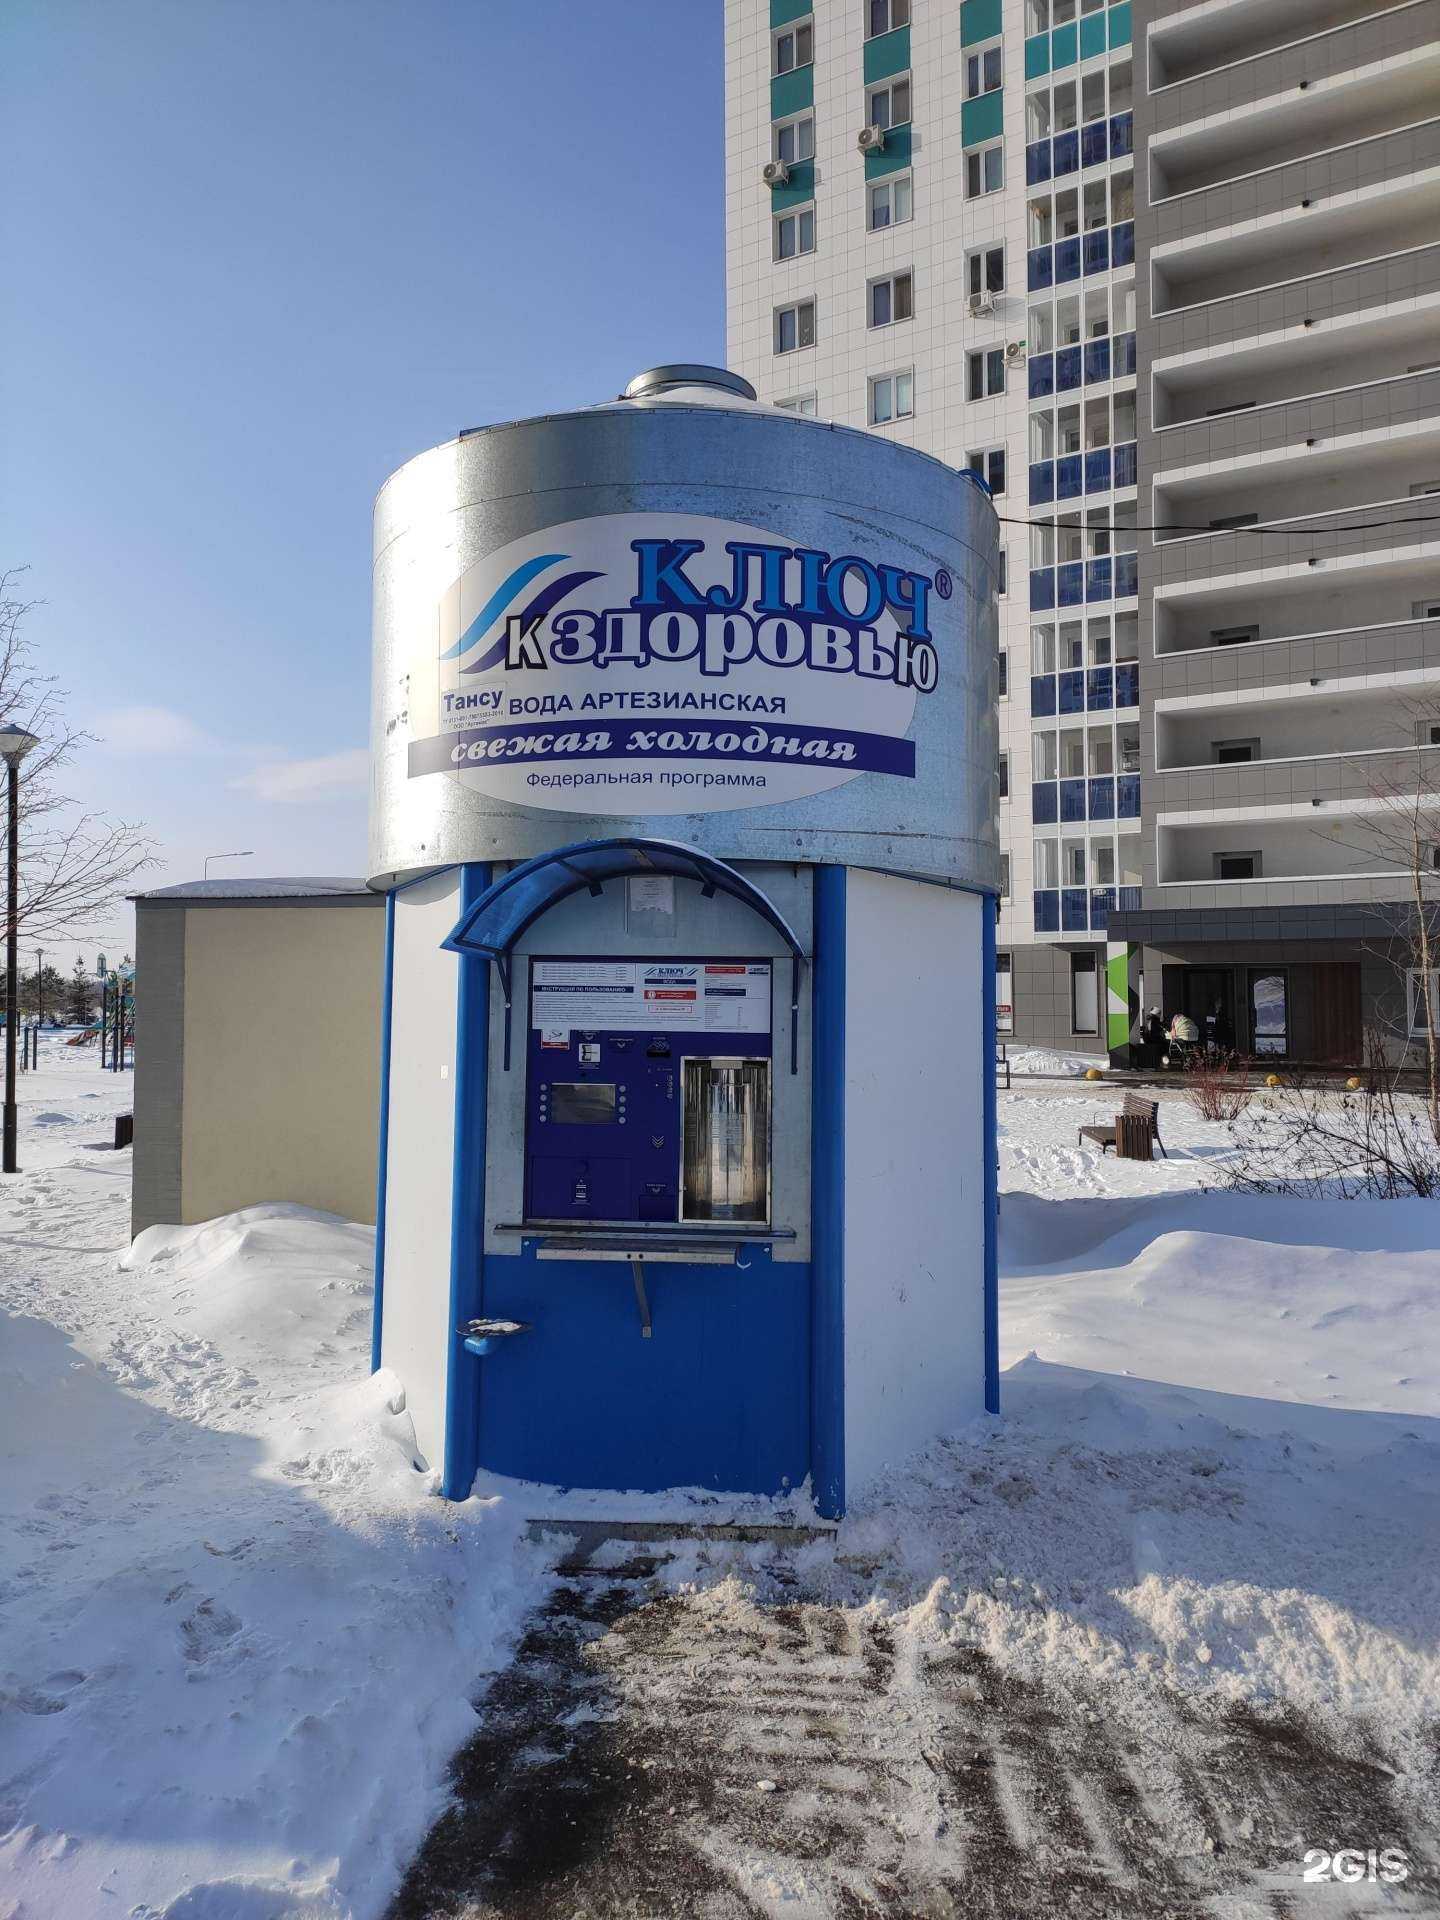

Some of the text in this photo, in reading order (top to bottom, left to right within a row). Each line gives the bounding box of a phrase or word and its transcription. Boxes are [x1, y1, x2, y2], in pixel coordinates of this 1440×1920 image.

[443, 690, 503, 713] Тансу
[509, 691, 786, 716] ВОДА АРТЕЗИАНСКАЯ
[450, 725, 858, 763] свежая холодная
[526, 772, 767, 788] Федеральная программа
